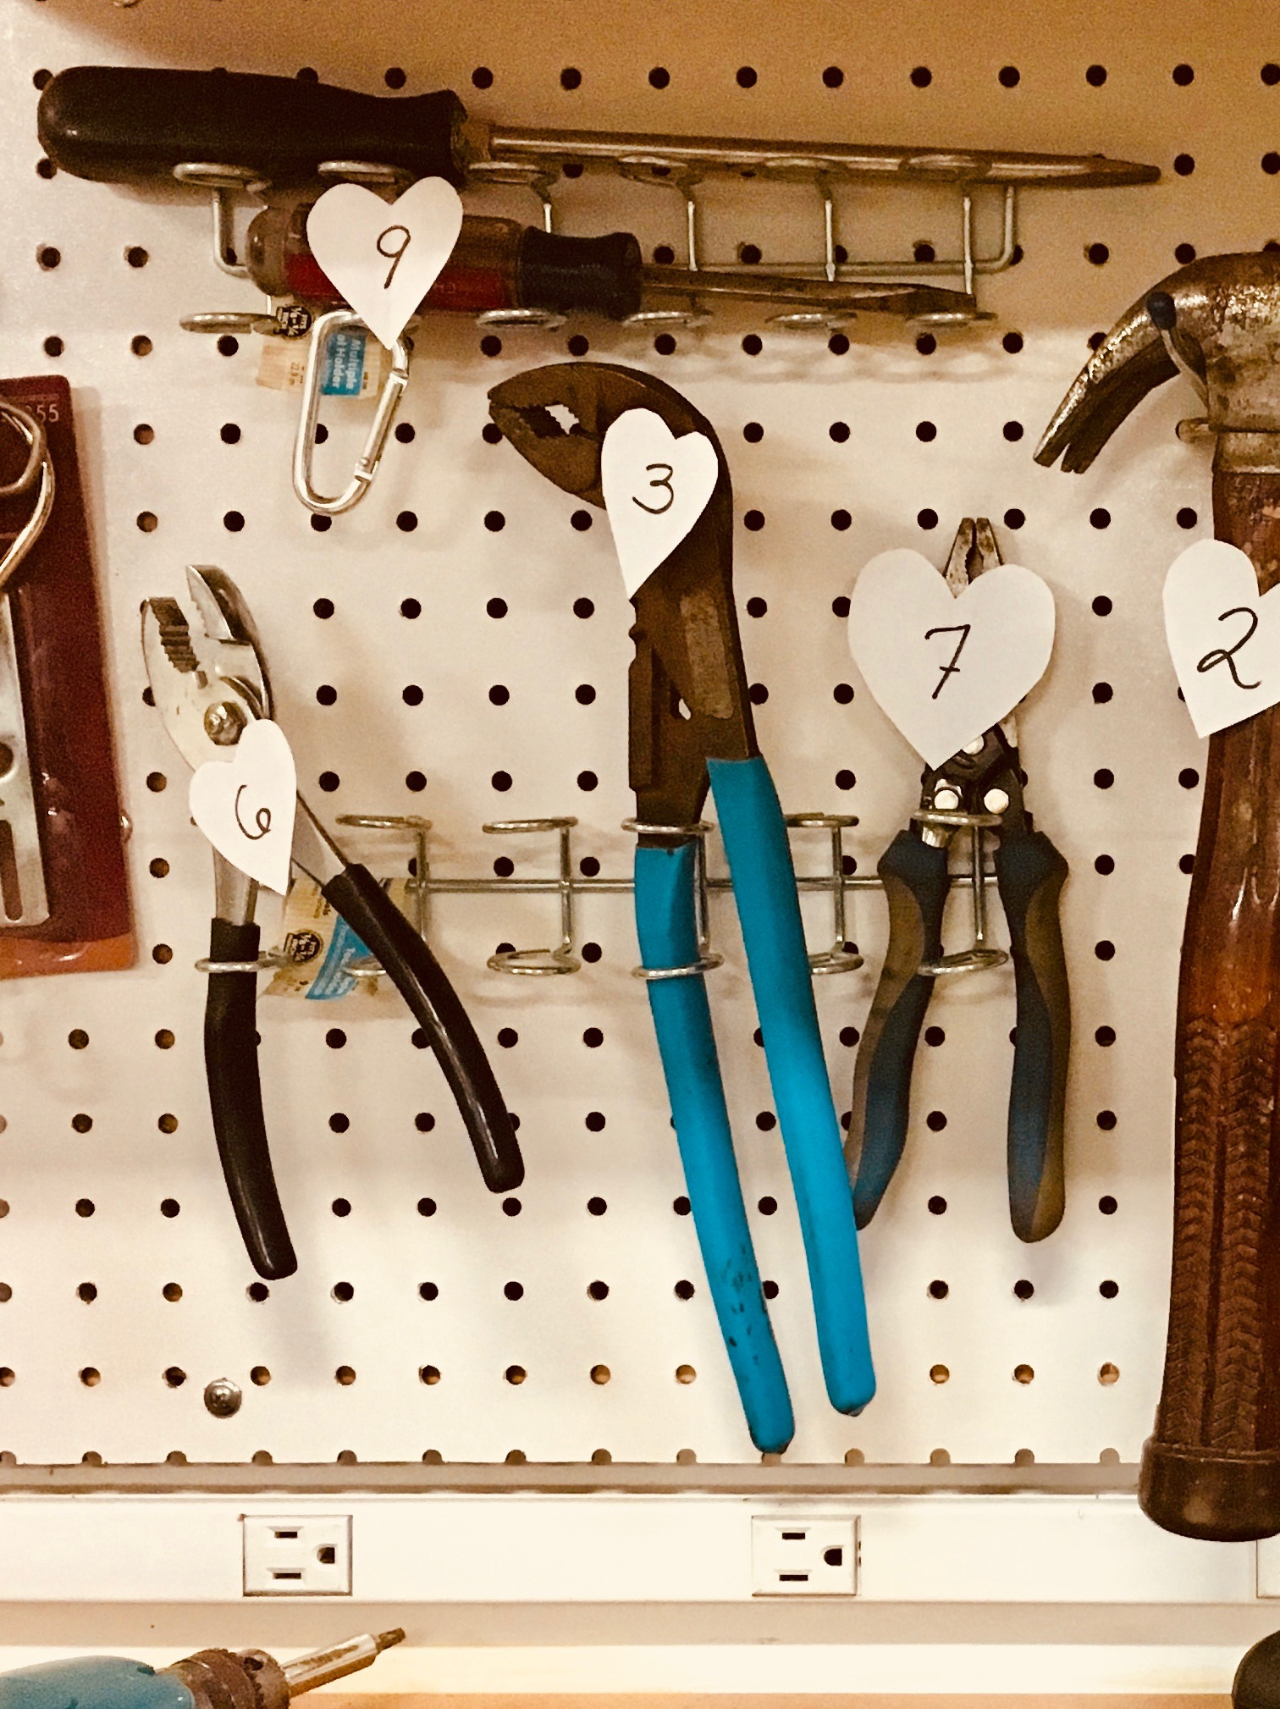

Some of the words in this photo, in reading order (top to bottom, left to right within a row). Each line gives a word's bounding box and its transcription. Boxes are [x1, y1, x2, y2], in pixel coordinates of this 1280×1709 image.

[376, 225, 411, 290] 9
[632, 463, 674, 515] 3
[924, 623, 972, 700] 7
[1196, 606, 1261, 690] 2
[235, 784, 272, 840] 6
